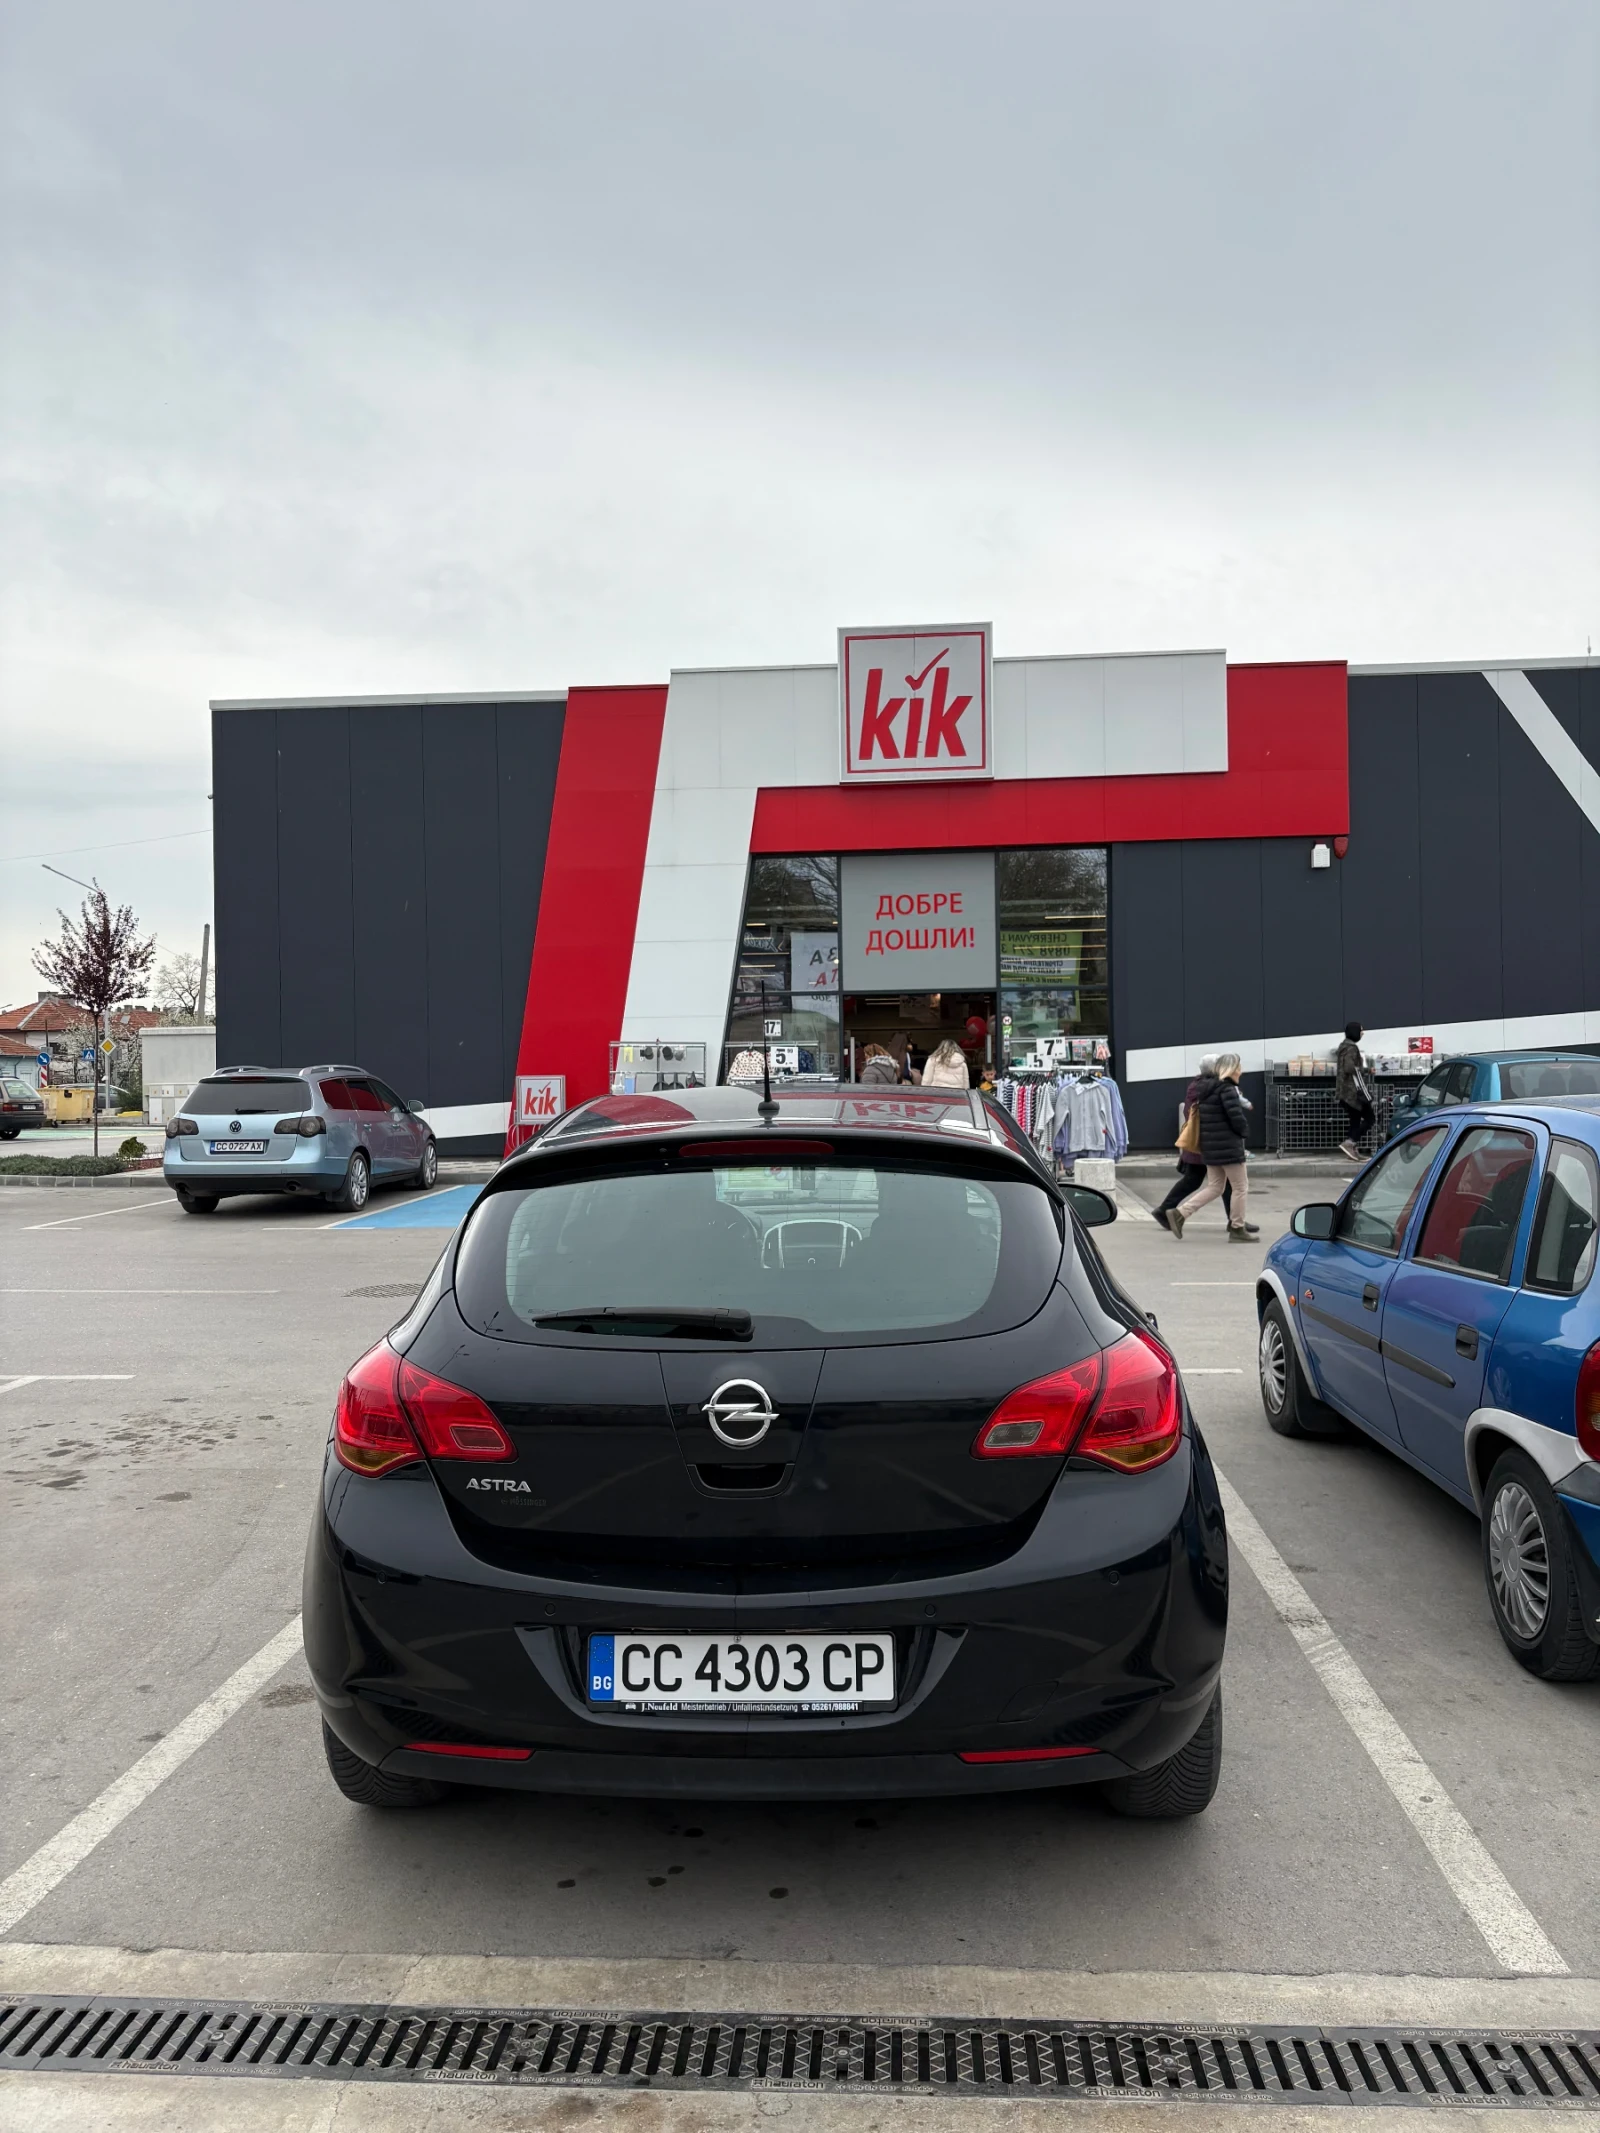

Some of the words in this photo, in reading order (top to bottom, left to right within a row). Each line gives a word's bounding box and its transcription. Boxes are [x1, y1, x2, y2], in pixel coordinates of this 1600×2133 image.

[876, 892, 963, 920] ДОБРЕ
[865, 928, 975, 955] ДОШЛИ!
[1044, 1040, 1055, 1056] 7
[775, 1048, 787, 1065] 5
[216, 1142, 228, 1151] CC
[228, 1142, 250, 1151] 0727
[250, 1142, 262, 1151] AX
[466, 1477, 532, 1493] ASTRA
[593, 1676, 612, 1691] BG
[621, 1643, 682, 1692] CC
[694, 1643, 810, 1692] 4303
[822, 1643, 885, 1692] CP
[438, 2071, 497, 2081] hauraton
[763, 2078, 824, 2089] hauraton
[1100, 2087, 1161, 2098] hauraton
